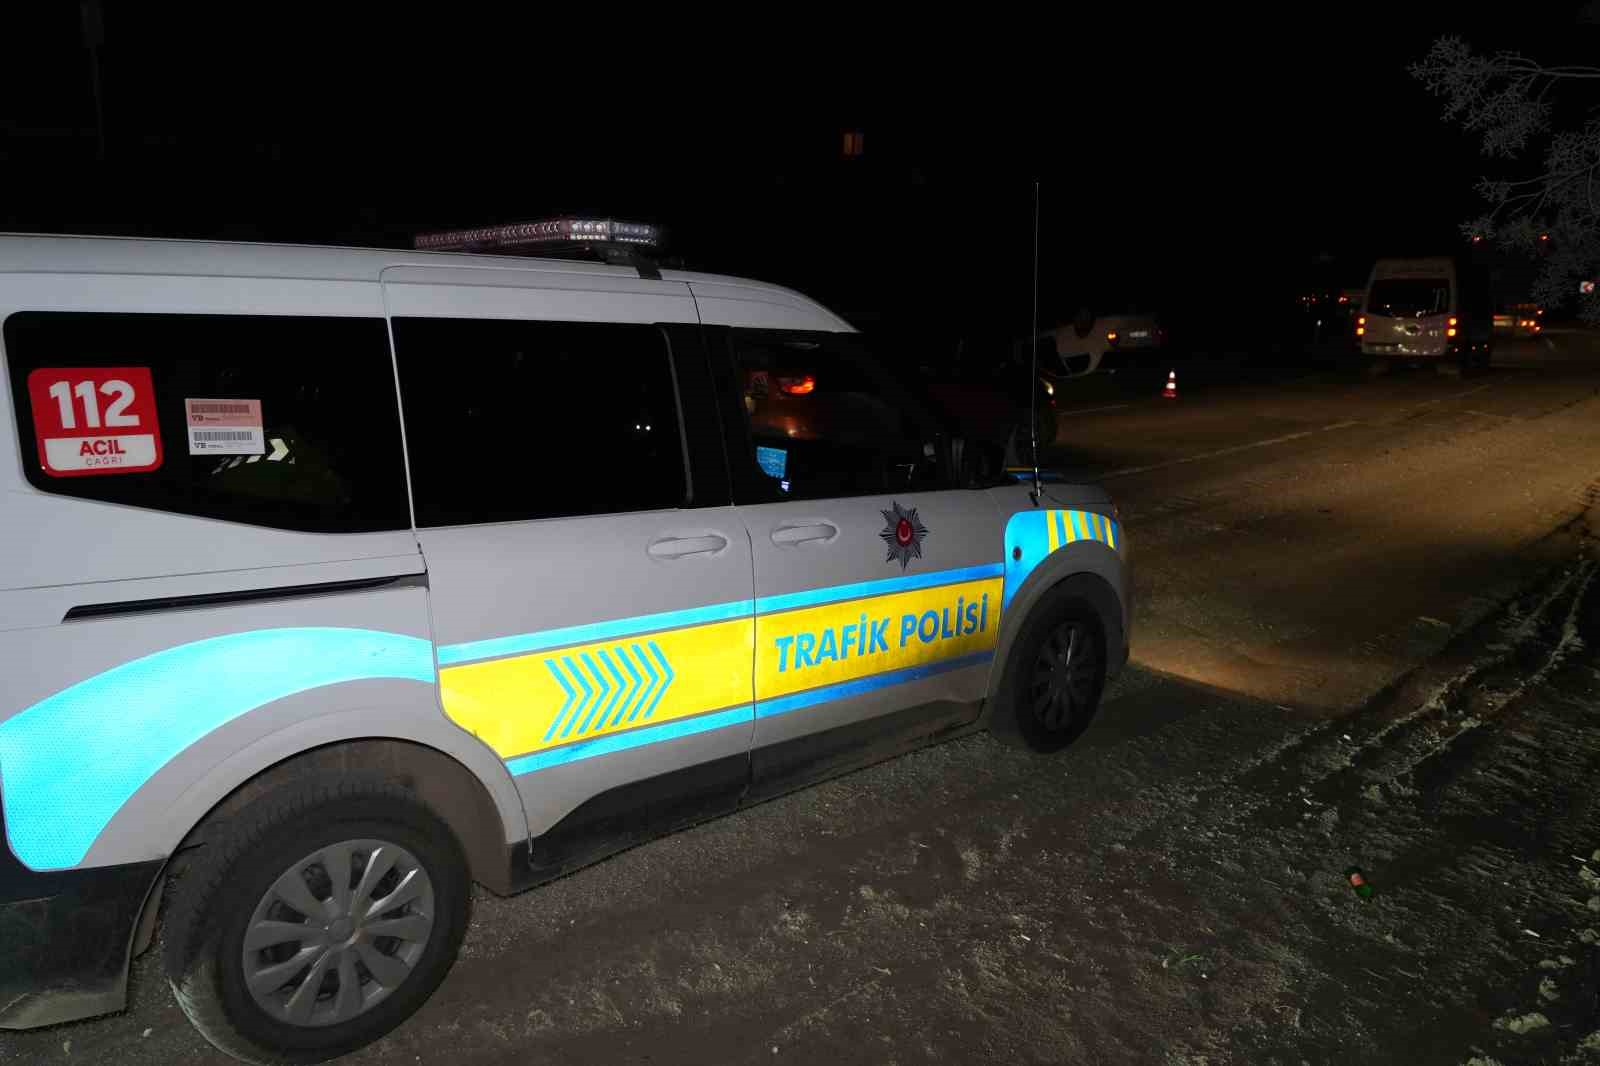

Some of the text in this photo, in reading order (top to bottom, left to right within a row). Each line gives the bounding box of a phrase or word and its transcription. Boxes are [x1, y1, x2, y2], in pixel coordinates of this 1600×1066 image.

[49, 380, 140, 429] 112
[775, 592, 988, 672] TRAFİK POLİSİ
